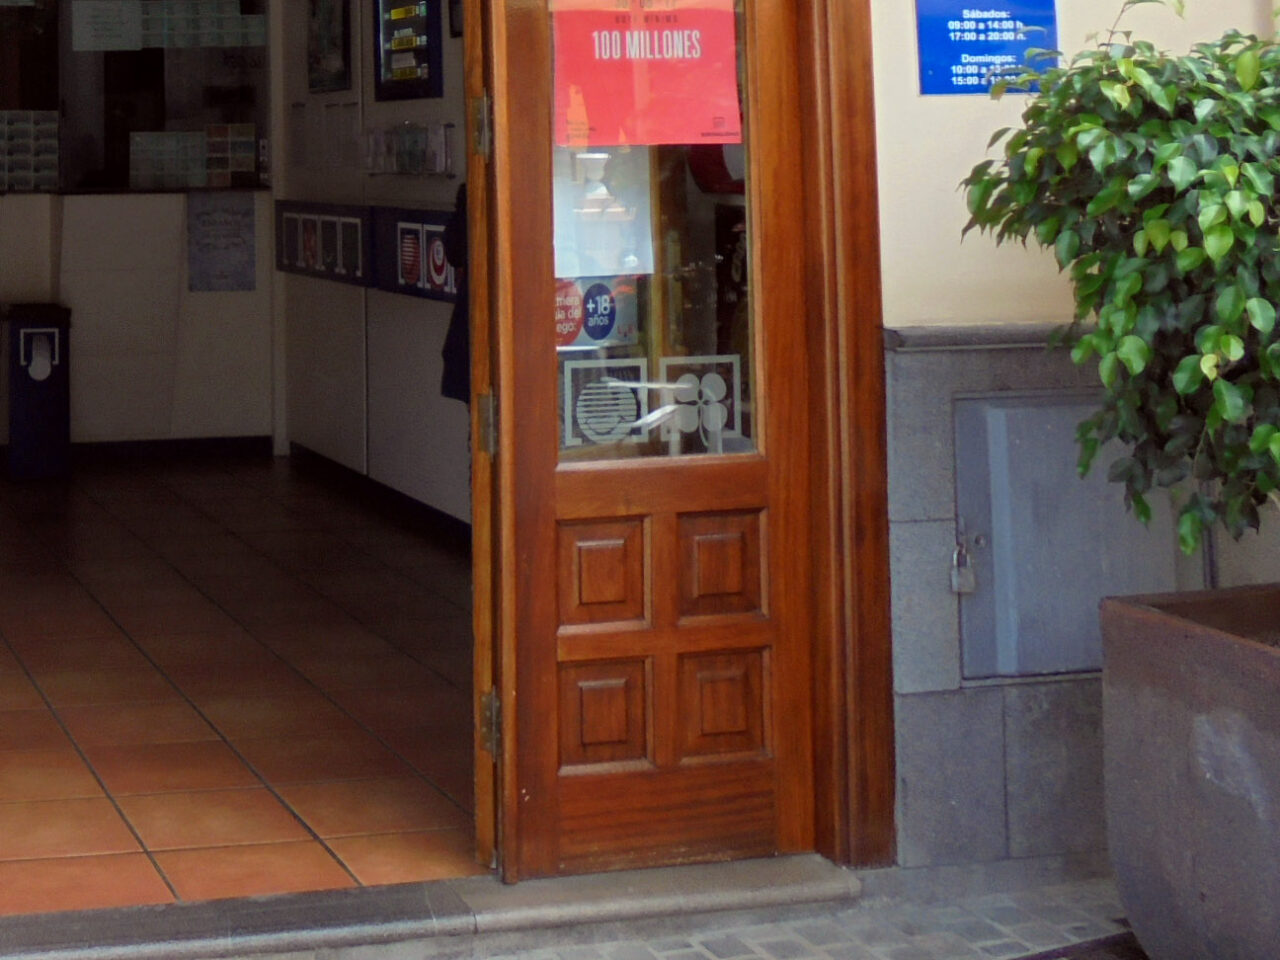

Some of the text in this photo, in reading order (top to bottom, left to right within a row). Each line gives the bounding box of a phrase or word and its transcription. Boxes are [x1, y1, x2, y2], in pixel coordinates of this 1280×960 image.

[962, 9, 1012, 19] Sábados:
[592, 29, 701, 60] 100 MILLONES
[961, 53, 1017, 64] Domingos:
[586, 295, 611, 315] +18
[588, 315, 609, 327] años
